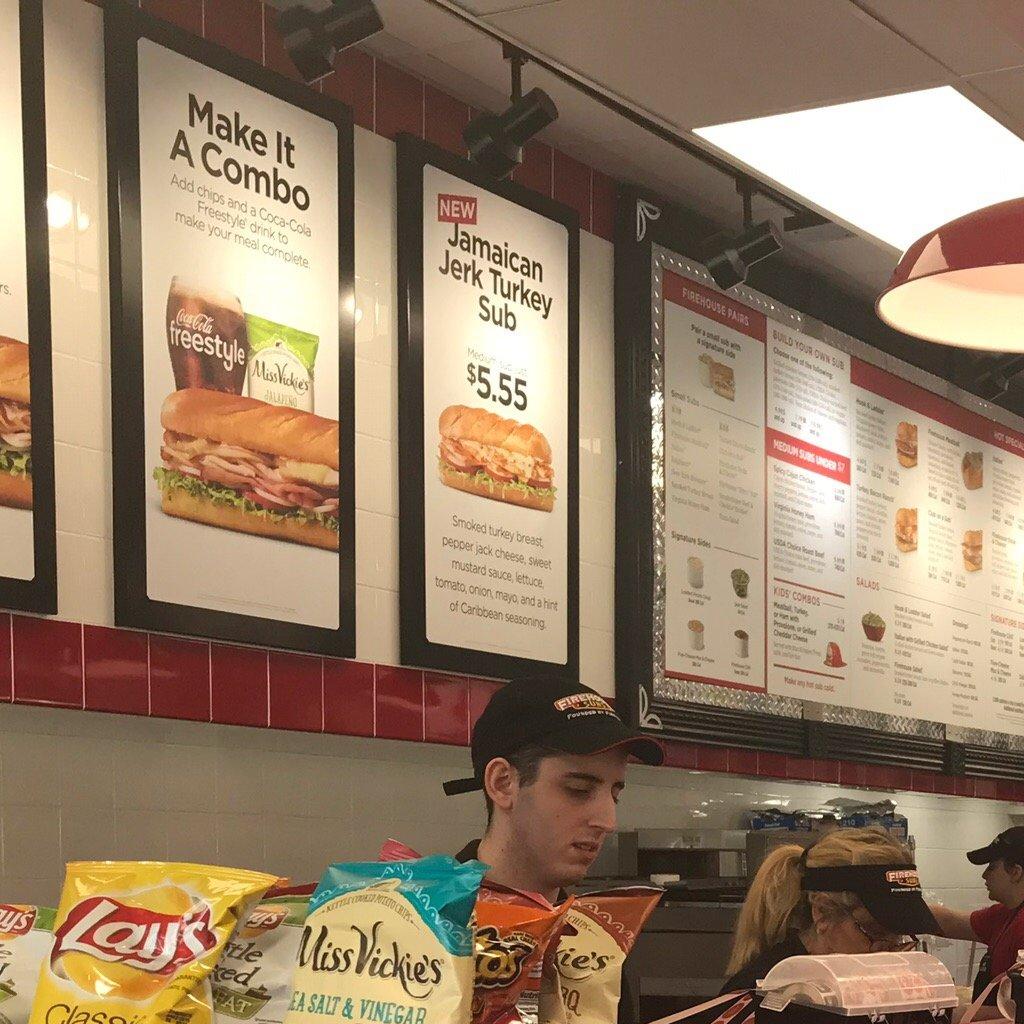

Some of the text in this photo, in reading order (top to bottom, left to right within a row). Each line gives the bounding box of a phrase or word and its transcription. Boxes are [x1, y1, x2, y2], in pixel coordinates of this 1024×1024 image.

[188, 92, 295, 169] Make It
[170, 129, 311, 211] A Combo
[170, 174, 312, 238] Add chips and a Coca-Cola
[439, 198, 476, 220] NEW
[175, 211, 311, 270] make your meal complete.
[250, 220, 289, 245] drink to
[447, 222, 544, 283] Jamaican
[439, 249, 553, 320] Jerk Turkey
[478, 295, 517, 331] Sub
[682, 287, 750, 328] FIREHOUSE PAIRS
[170, 320, 246, 372] freestyle
[772, 329, 845, 370] BUILD YOUR OWN SUB
[252, 360, 279, 385] Miss
[467, 362, 528, 412] $5.55
[773, 439, 798, 459] MEDIUM
[798, 449, 815, 465] SUBS
[452, 514, 545, 549] Smoked turkey breast,
[671, 530, 696, 546] Signature
[442, 536, 553, 571] pepper jack cheese, sweet
[451, 559, 545, 589] mustard sauce, lettuce,
[856, 576, 880, 592] SALADS
[434, 575, 558, 612] tomato, onion, mayo, and hint
[792, 591, 821, 607] COMBOS
[449, 600, 548, 631] of Caribbean seasoning.
[351, 893, 411, 922] COOKED CHIPS
[57, 898, 212, 975] Lay's
[299, 925, 355, 973] Miss
[350, 920, 442, 999] Vickie's
[307, 994, 341, 1018] SALT
[341, 997, 354, 1019] &
